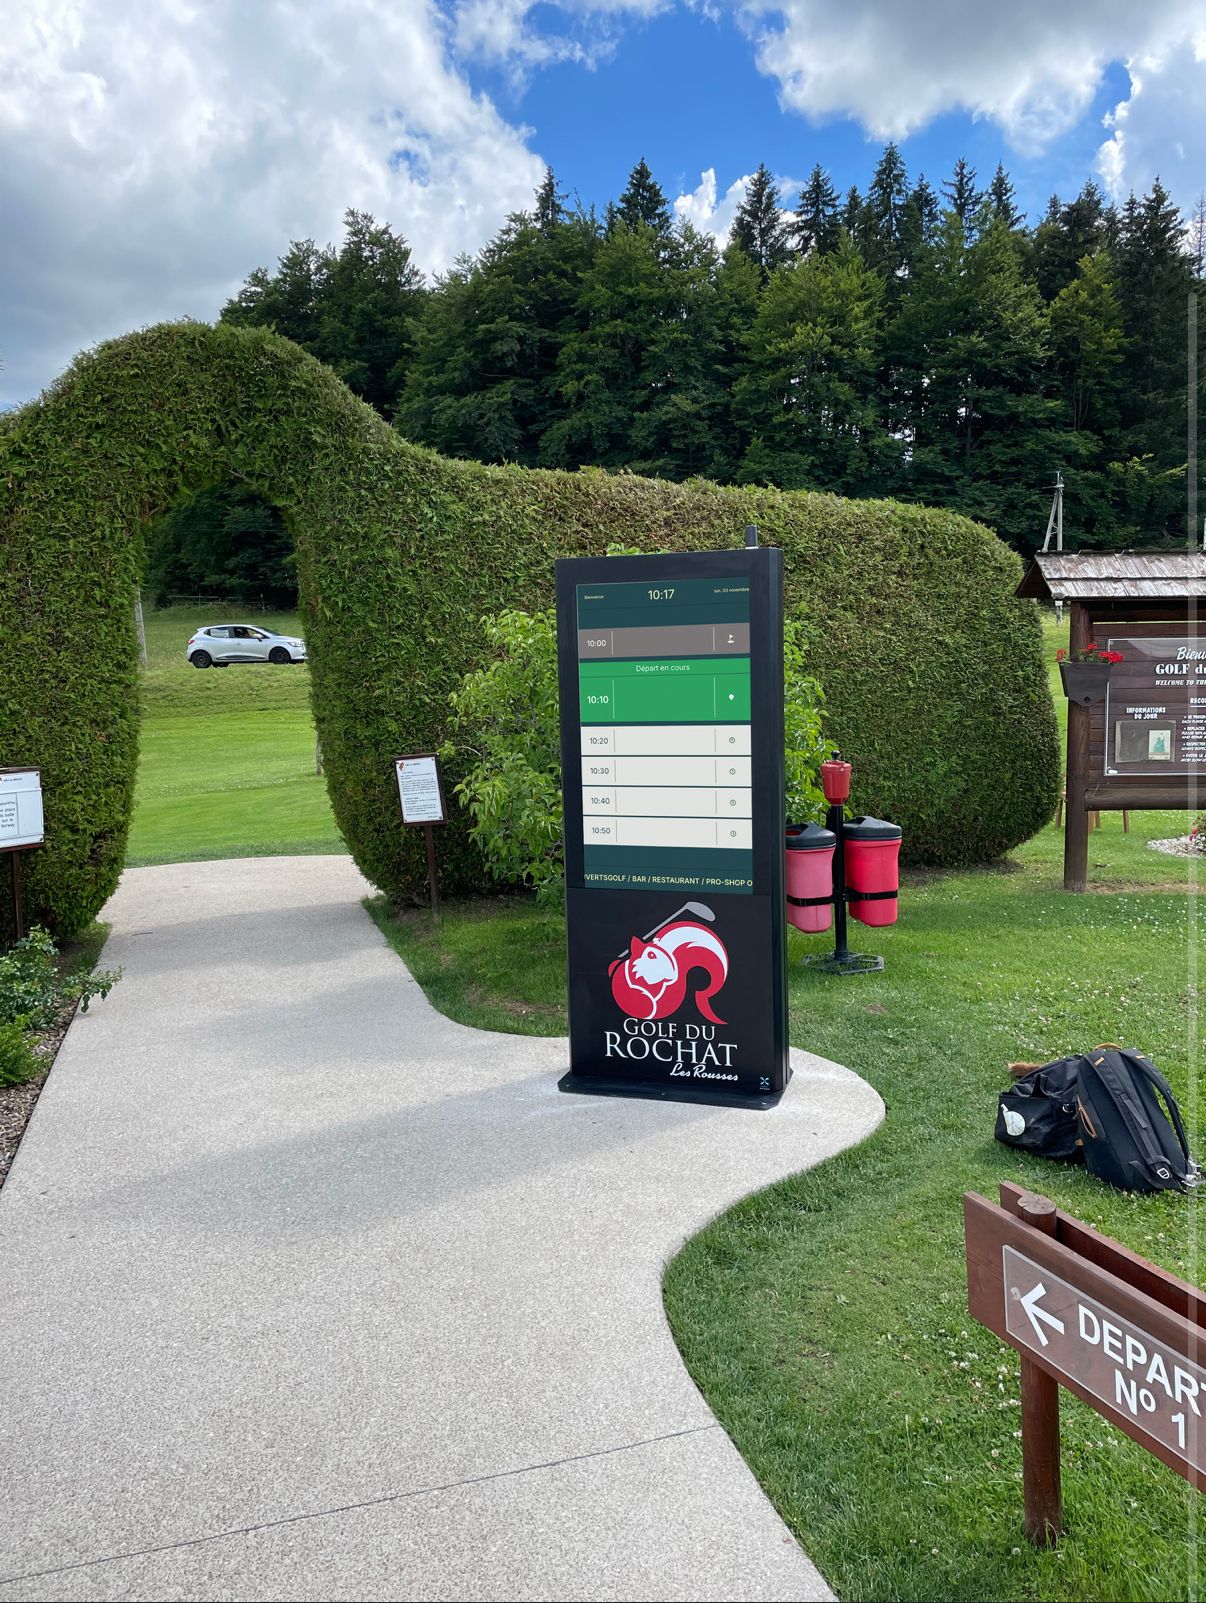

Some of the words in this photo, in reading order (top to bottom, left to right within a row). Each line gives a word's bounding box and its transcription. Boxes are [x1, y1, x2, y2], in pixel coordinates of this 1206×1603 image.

[647, 589, 675, 600] 10:17
[587, 639, 606, 647] 10:00
[635, 664, 659, 672] Départ
[1155, 663, 1190, 675] GOLF
[587, 695, 609, 704] 10:10
[1126, 706, 1166, 714] INFORMATIONS
[589, 737, 609, 745] 10:20
[590, 767, 610, 775] 10:30
[590, 797, 611, 805] 10:40
[591, 826, 611, 834] 10:50
[632, 875, 647, 883] BAR
[652, 876, 700, 885] RESTAURANT
[706, 878, 745, 886] PRO-SHOP
[623, 1017, 677, 1038] GOLF
[685, 1023, 716, 1041] DU
[604, 1030, 738, 1067] ROCHAT
[669, 1062, 691, 1077] Les
[692, 1064, 739, 1081] Rousses
[1115, 1368, 1156, 1416] No
[1171, 1411, 1186, 1451] 1
